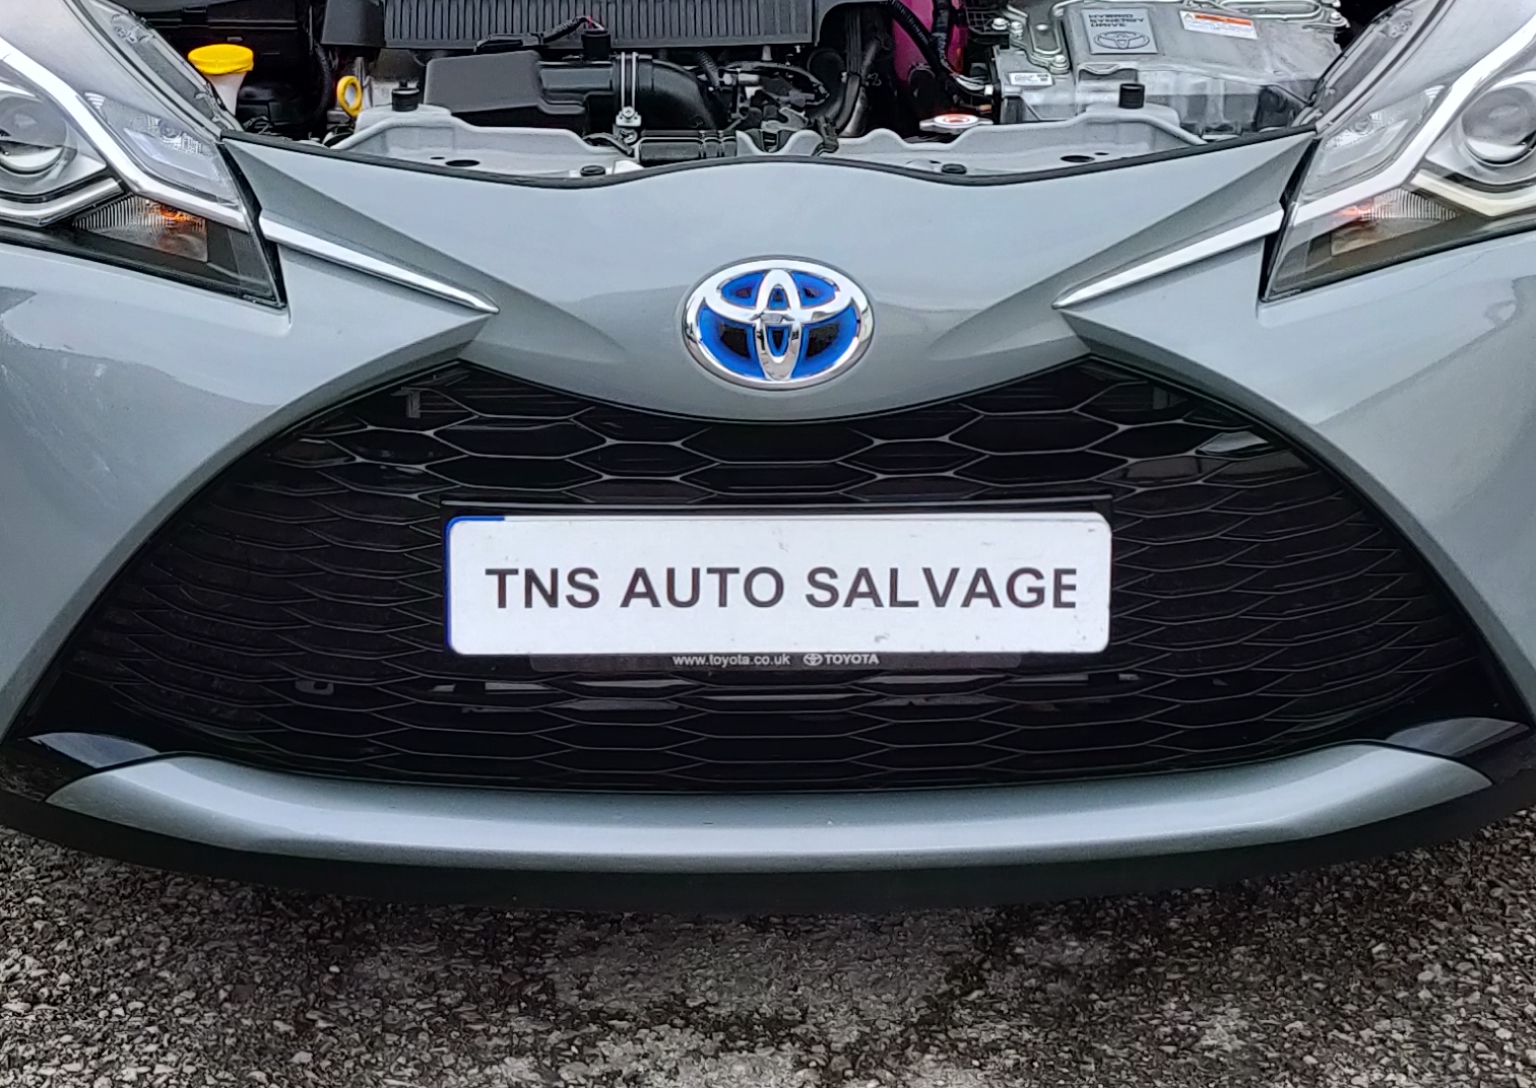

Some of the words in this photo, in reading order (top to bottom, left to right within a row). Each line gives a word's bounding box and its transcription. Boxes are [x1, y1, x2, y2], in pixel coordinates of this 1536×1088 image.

[485, 568, 600, 609] TNS
[620, 567, 785, 609] AUTO
[806, 567, 1077, 609] SALVAGE
[672, 654, 790, 668] www.toyota.co.uk
[824, 654, 880, 665] TOYOTA
